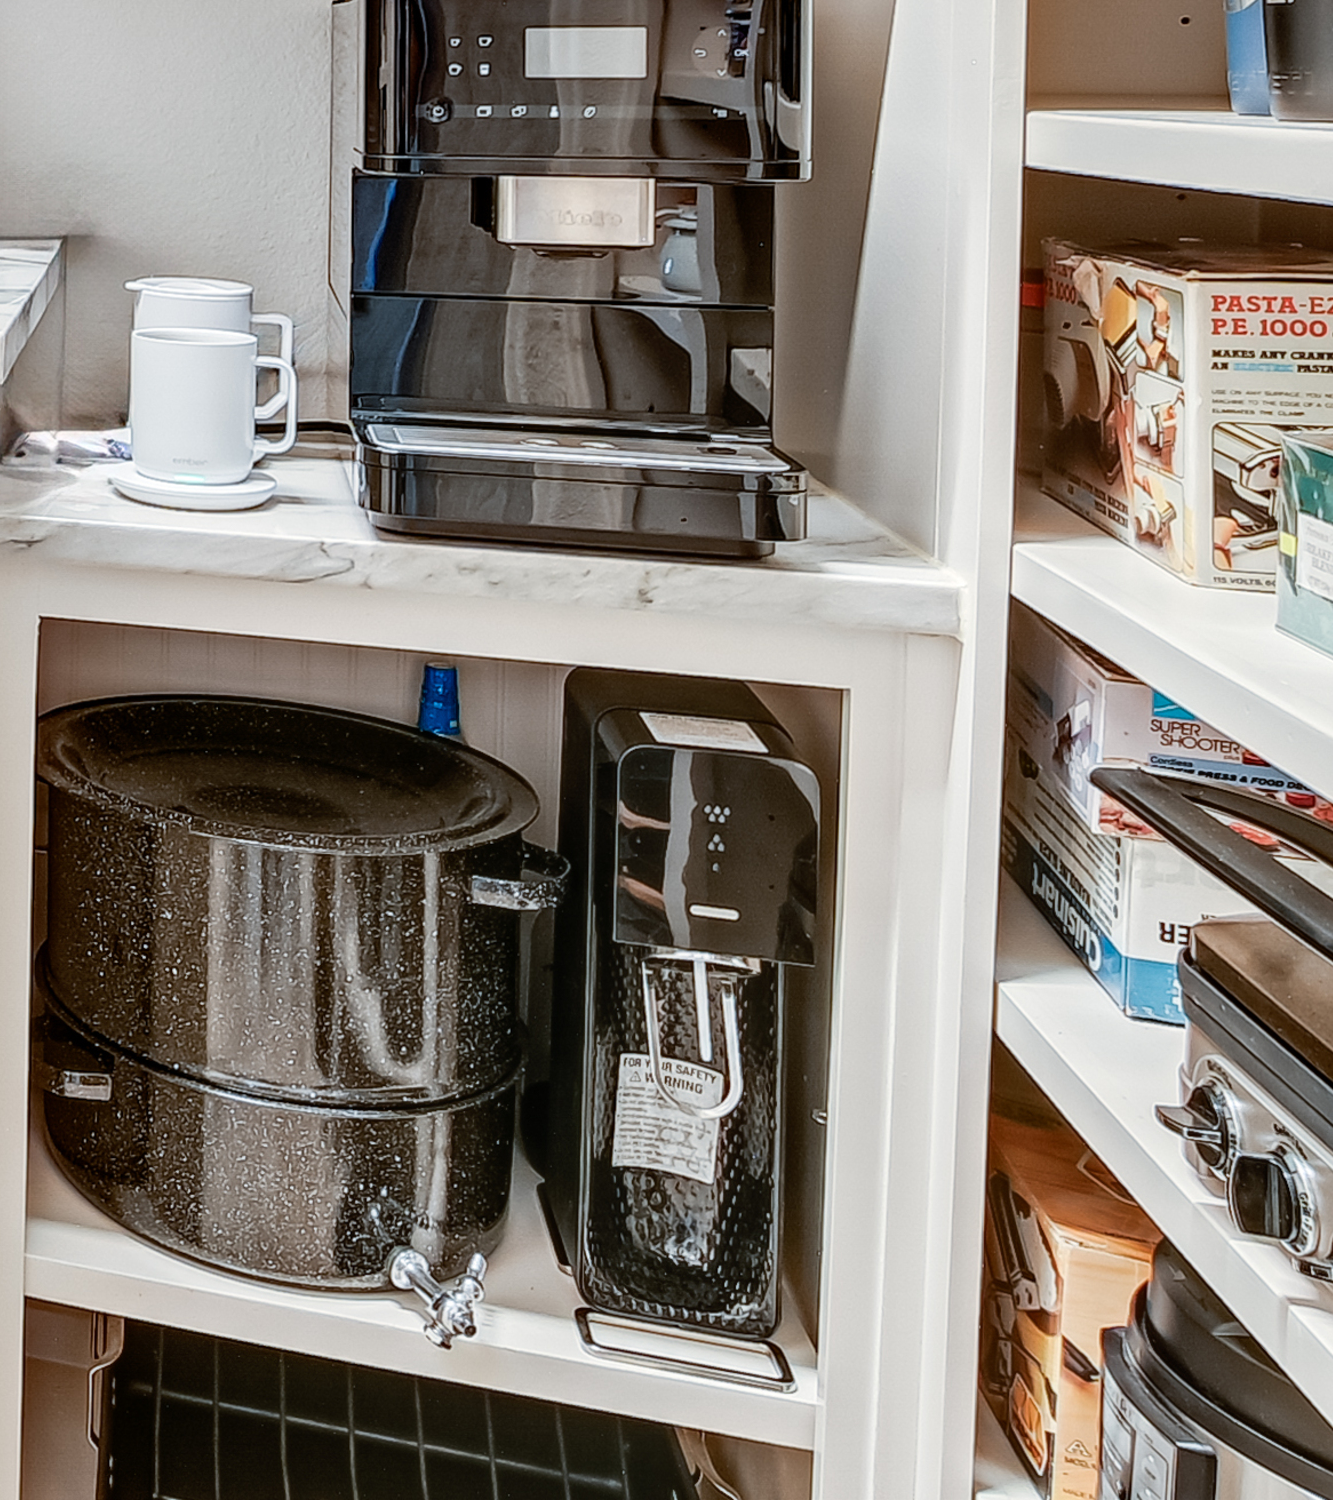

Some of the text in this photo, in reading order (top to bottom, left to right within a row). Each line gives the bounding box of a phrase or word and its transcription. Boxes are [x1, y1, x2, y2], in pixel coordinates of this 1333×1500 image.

[1259, 318, 1328, 338] 1000
[1211, 349, 1256, 359] MAKES
[1260, 350, 1288, 360] ANY
[1210, 362, 1229, 371] AN
[1150, 718, 1202, 737] SUPER
[1160, 733, 1241, 755] SHOOTER
[1150, 755, 1194, 768] Cordless
[1197, 770, 1238, 782] PRESS
[1250, 776, 1284, 788] FOOD
[1032, 861, 1104, 973] Cuisinart
[644, 1071, 704, 1095] WRNING
[675, 1063, 717, 1085] SAFETY
